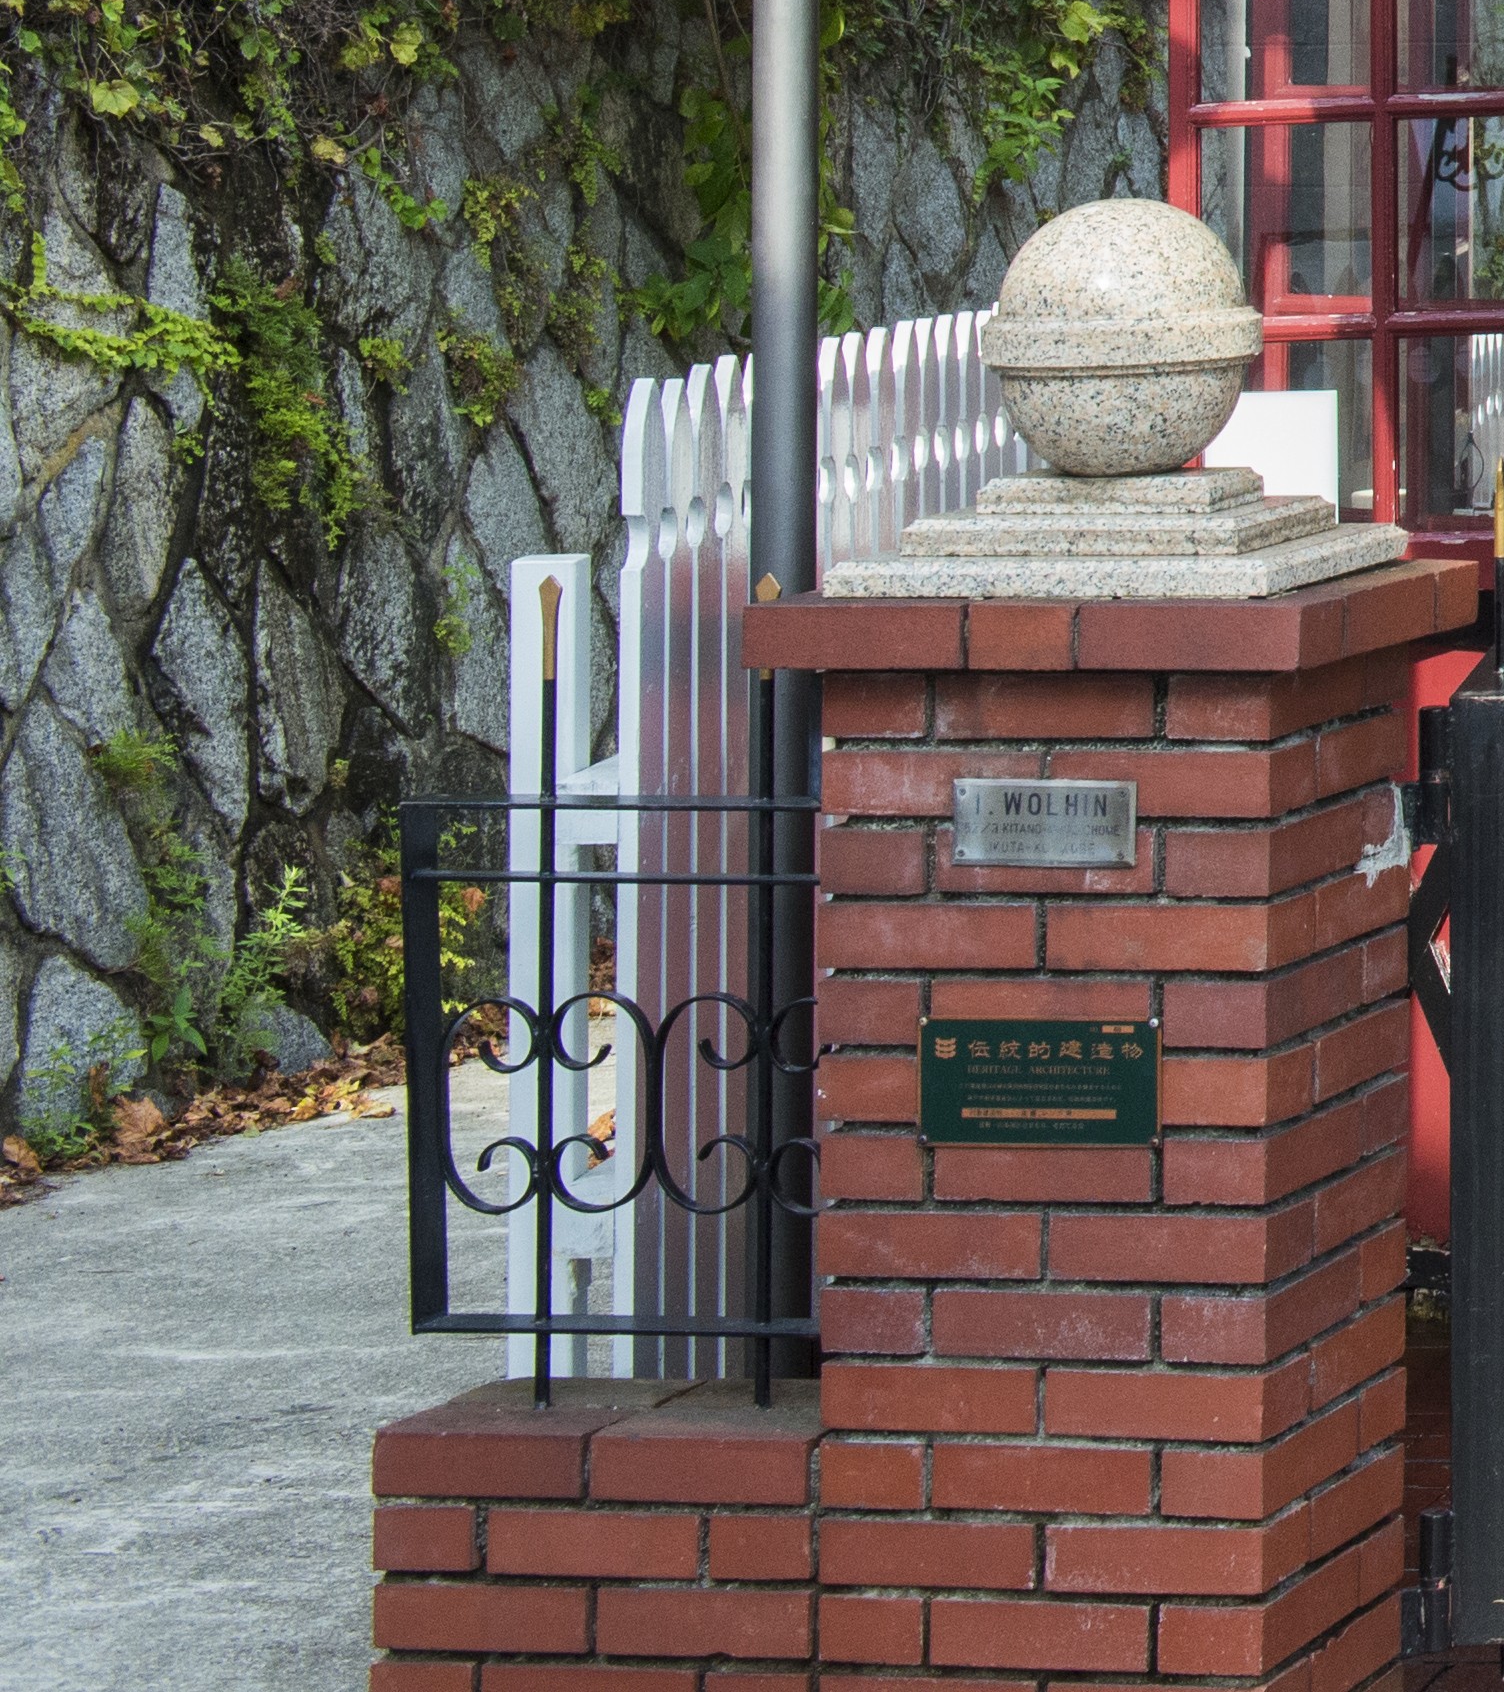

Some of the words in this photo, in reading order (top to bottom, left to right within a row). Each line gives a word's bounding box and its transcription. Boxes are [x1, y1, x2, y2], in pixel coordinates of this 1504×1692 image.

[1004, 792, 1108, 817] WOLHIN
[967, 1064, 1022, 1075] HERITAGE
[1029, 1065, 1110, 1076] ARCHITECTURE
